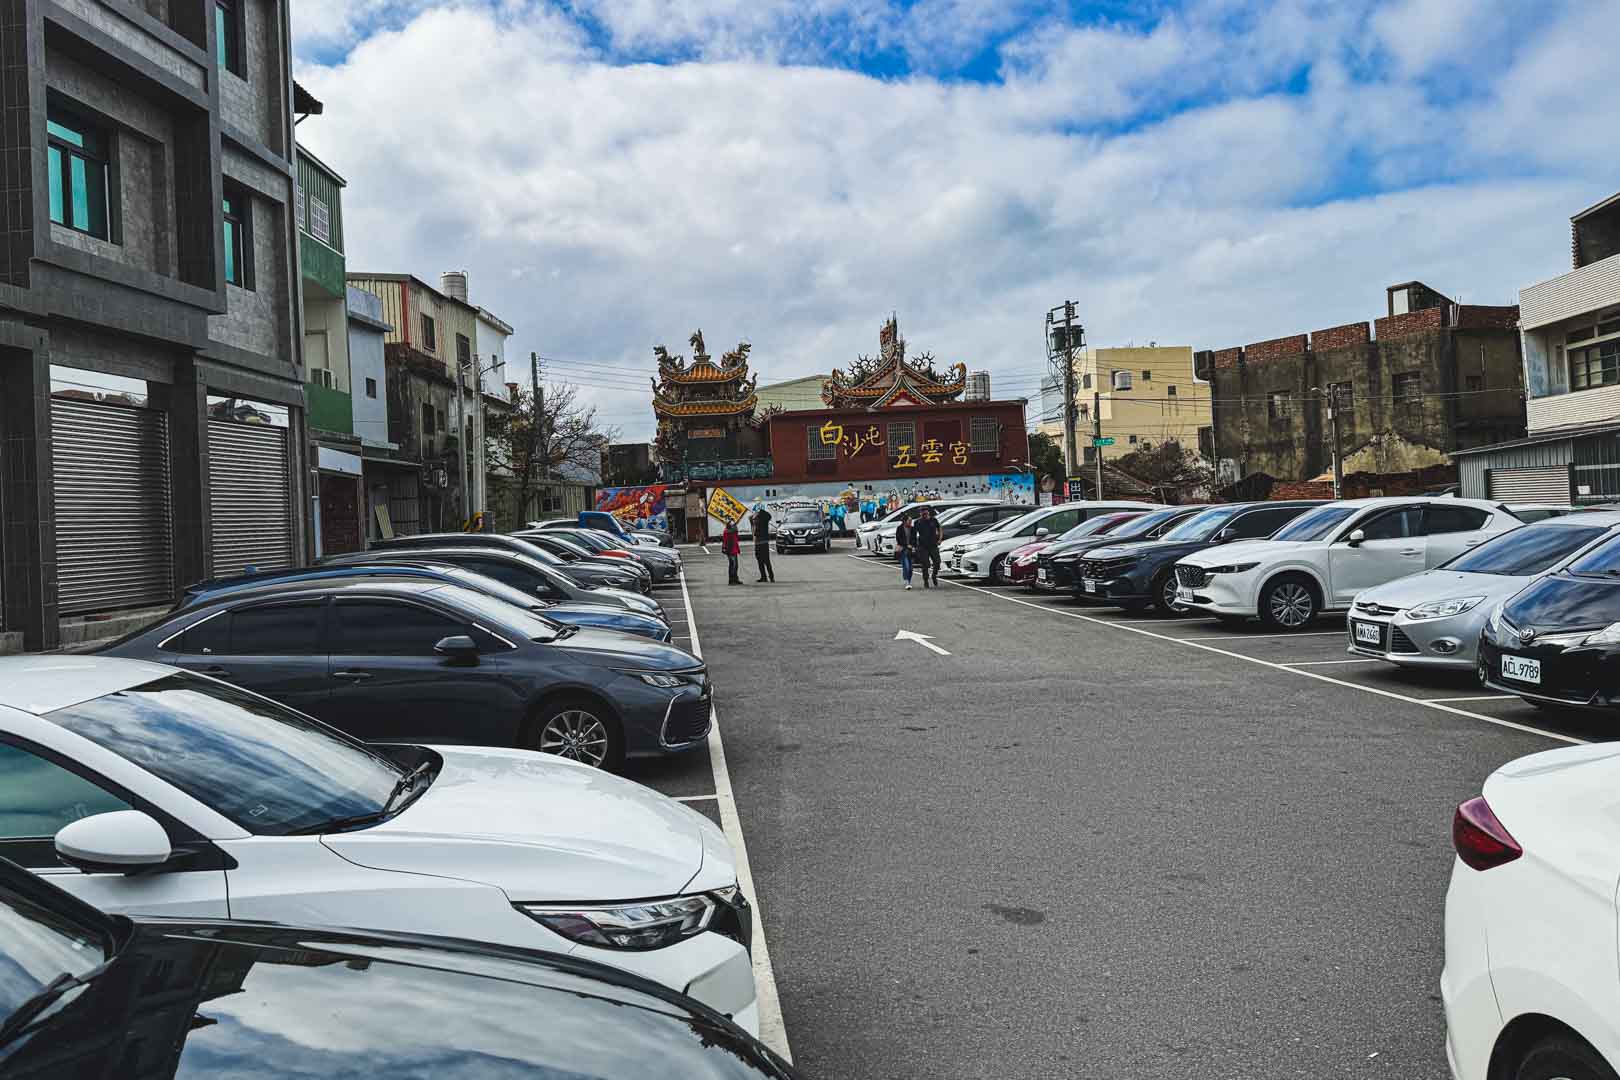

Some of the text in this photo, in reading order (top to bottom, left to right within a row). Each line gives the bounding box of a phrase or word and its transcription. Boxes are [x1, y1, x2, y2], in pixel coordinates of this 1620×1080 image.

[820, 420, 971, 468] 白沙屯 五雲宮
